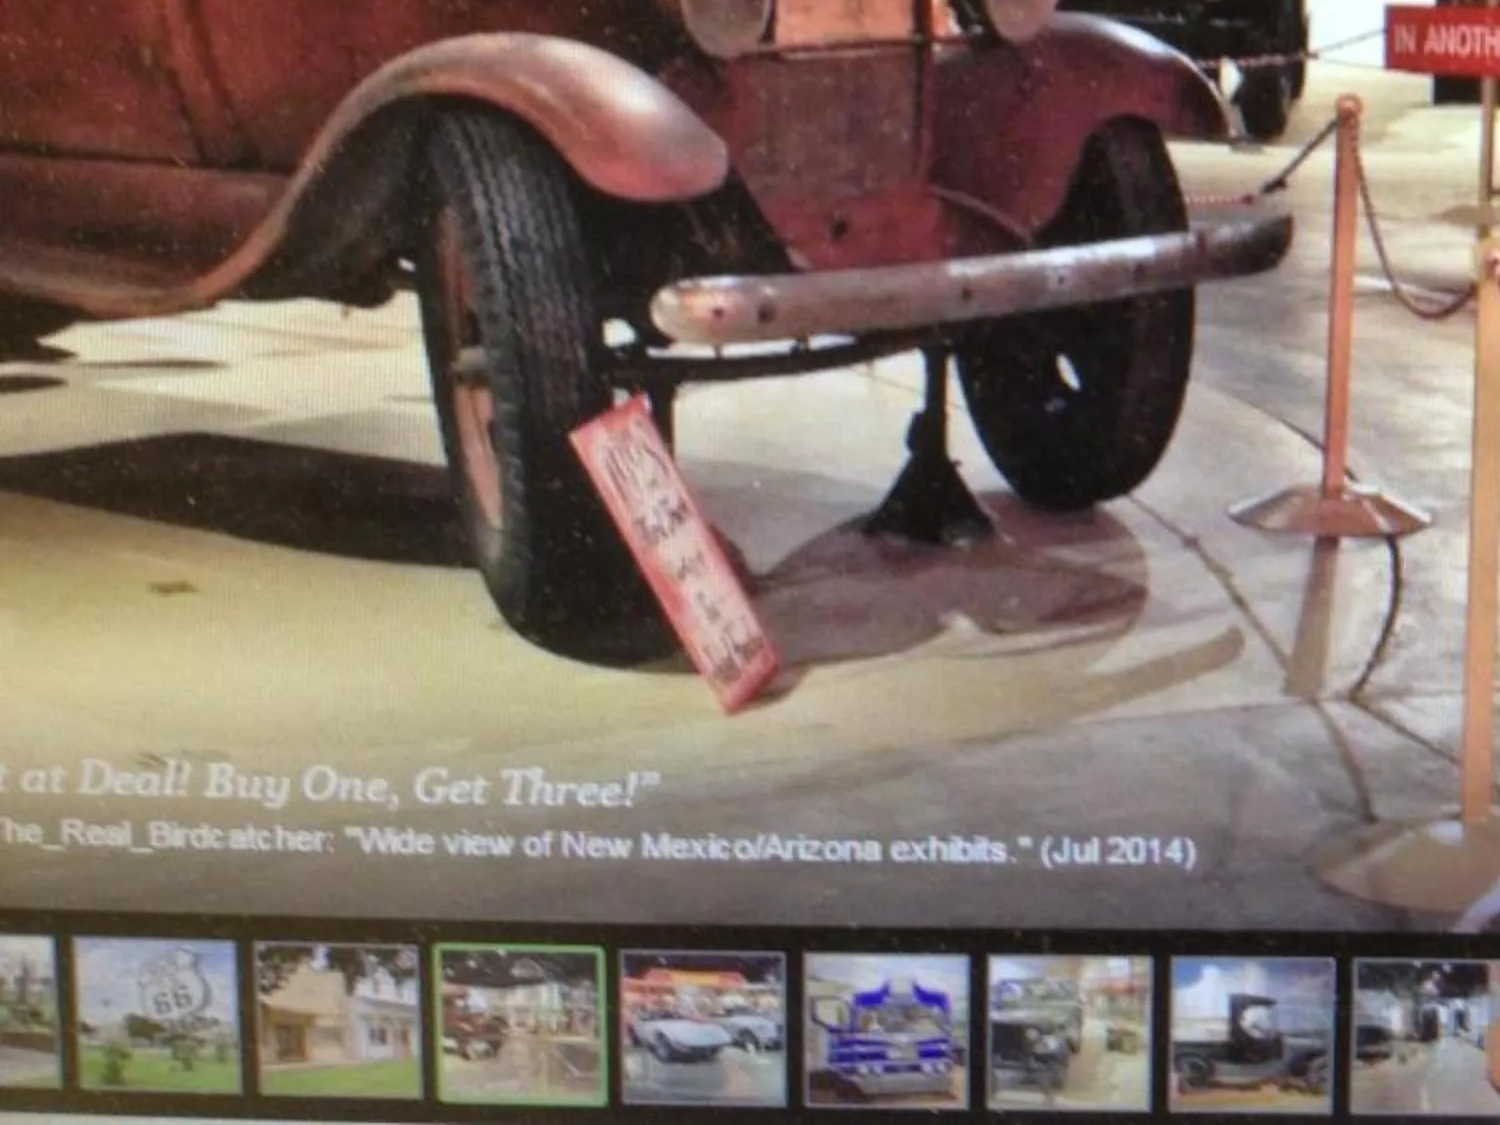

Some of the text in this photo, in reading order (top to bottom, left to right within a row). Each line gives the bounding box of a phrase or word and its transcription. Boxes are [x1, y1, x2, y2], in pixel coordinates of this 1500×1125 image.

[1393, 23, 1418, 55] IN
[20, 765, 67, 794] at
[77, 757, 192, 797] Deal!
[203, 762, 291, 809] Buy
[302, 764, 400, 812] One,
[413, 766, 491, 806] Get
[443, 828, 514, 858] view
[523, 829, 552, 858] of
[561, 830, 634, 860] New
[640, 831, 882, 864] Mexico/Arizona
[1041, 835, 1100, 870] (Jul
[1106, 835, 1197, 871] 2014)
